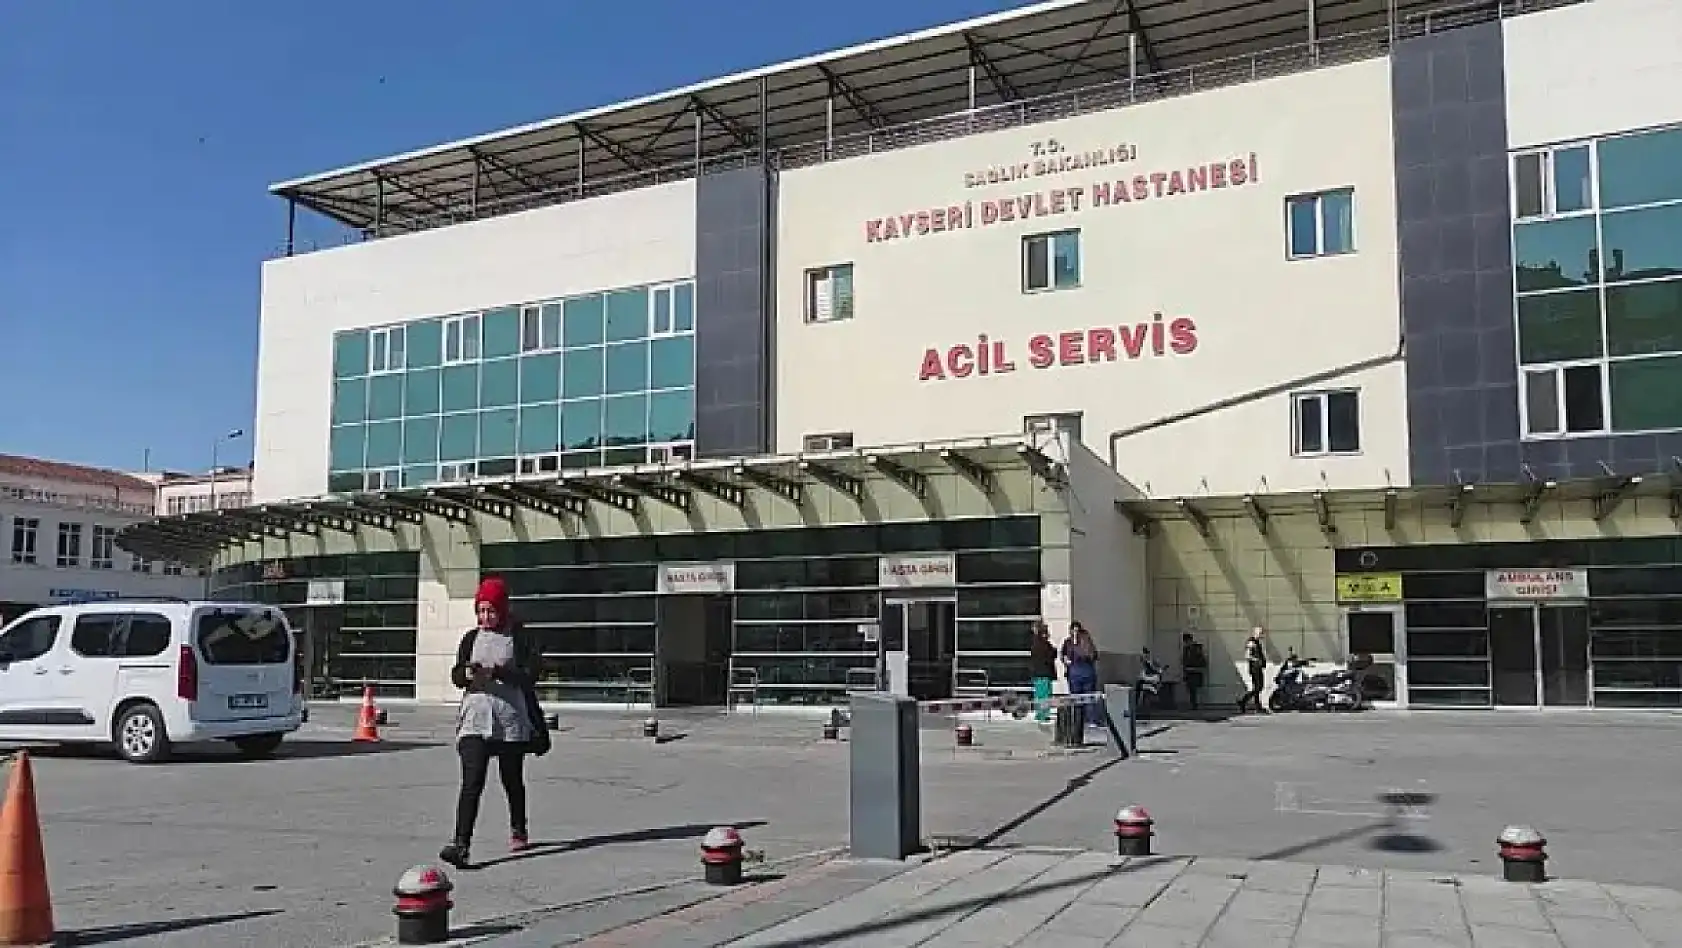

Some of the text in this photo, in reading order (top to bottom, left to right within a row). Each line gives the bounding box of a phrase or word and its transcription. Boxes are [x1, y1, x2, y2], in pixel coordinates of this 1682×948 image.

[866, 151, 1258, 243] KAYSERİ DEVLET HASTANESİ
[918, 311, 1199, 381] ACİL SERVİS
